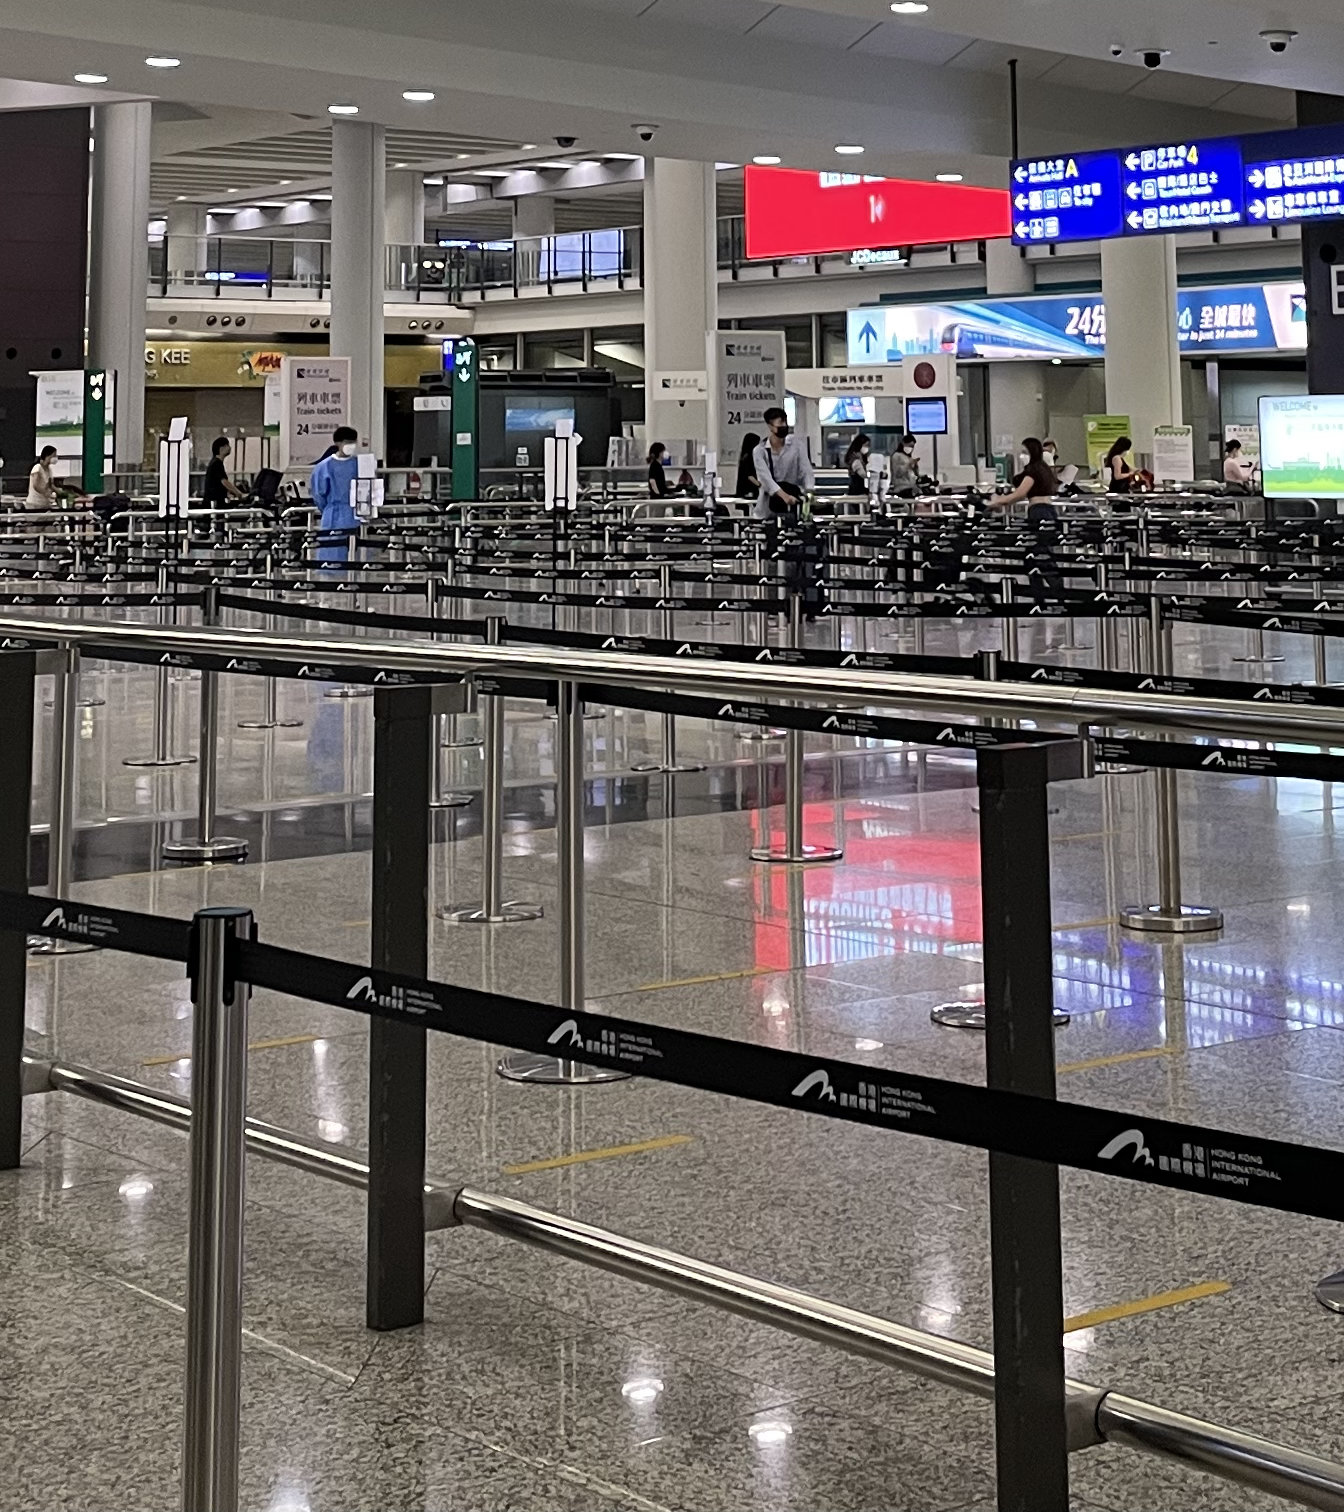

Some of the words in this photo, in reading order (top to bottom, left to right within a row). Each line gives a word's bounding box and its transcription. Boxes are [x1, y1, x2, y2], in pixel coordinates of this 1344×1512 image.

[1187, 145, 1198, 165] 4
[1065, 158, 1079, 178] A
[160, 348, 191, 364] KEE
[726, 390, 747, 400] Train
[749, 390, 776, 400] tickets
[297, 407, 316, 415] Train
[317, 407, 342, 415] tickets
[1272, 400, 1311, 412] WELCOME
[727, 411, 741, 425] 24
[297, 424, 309, 435] 24
